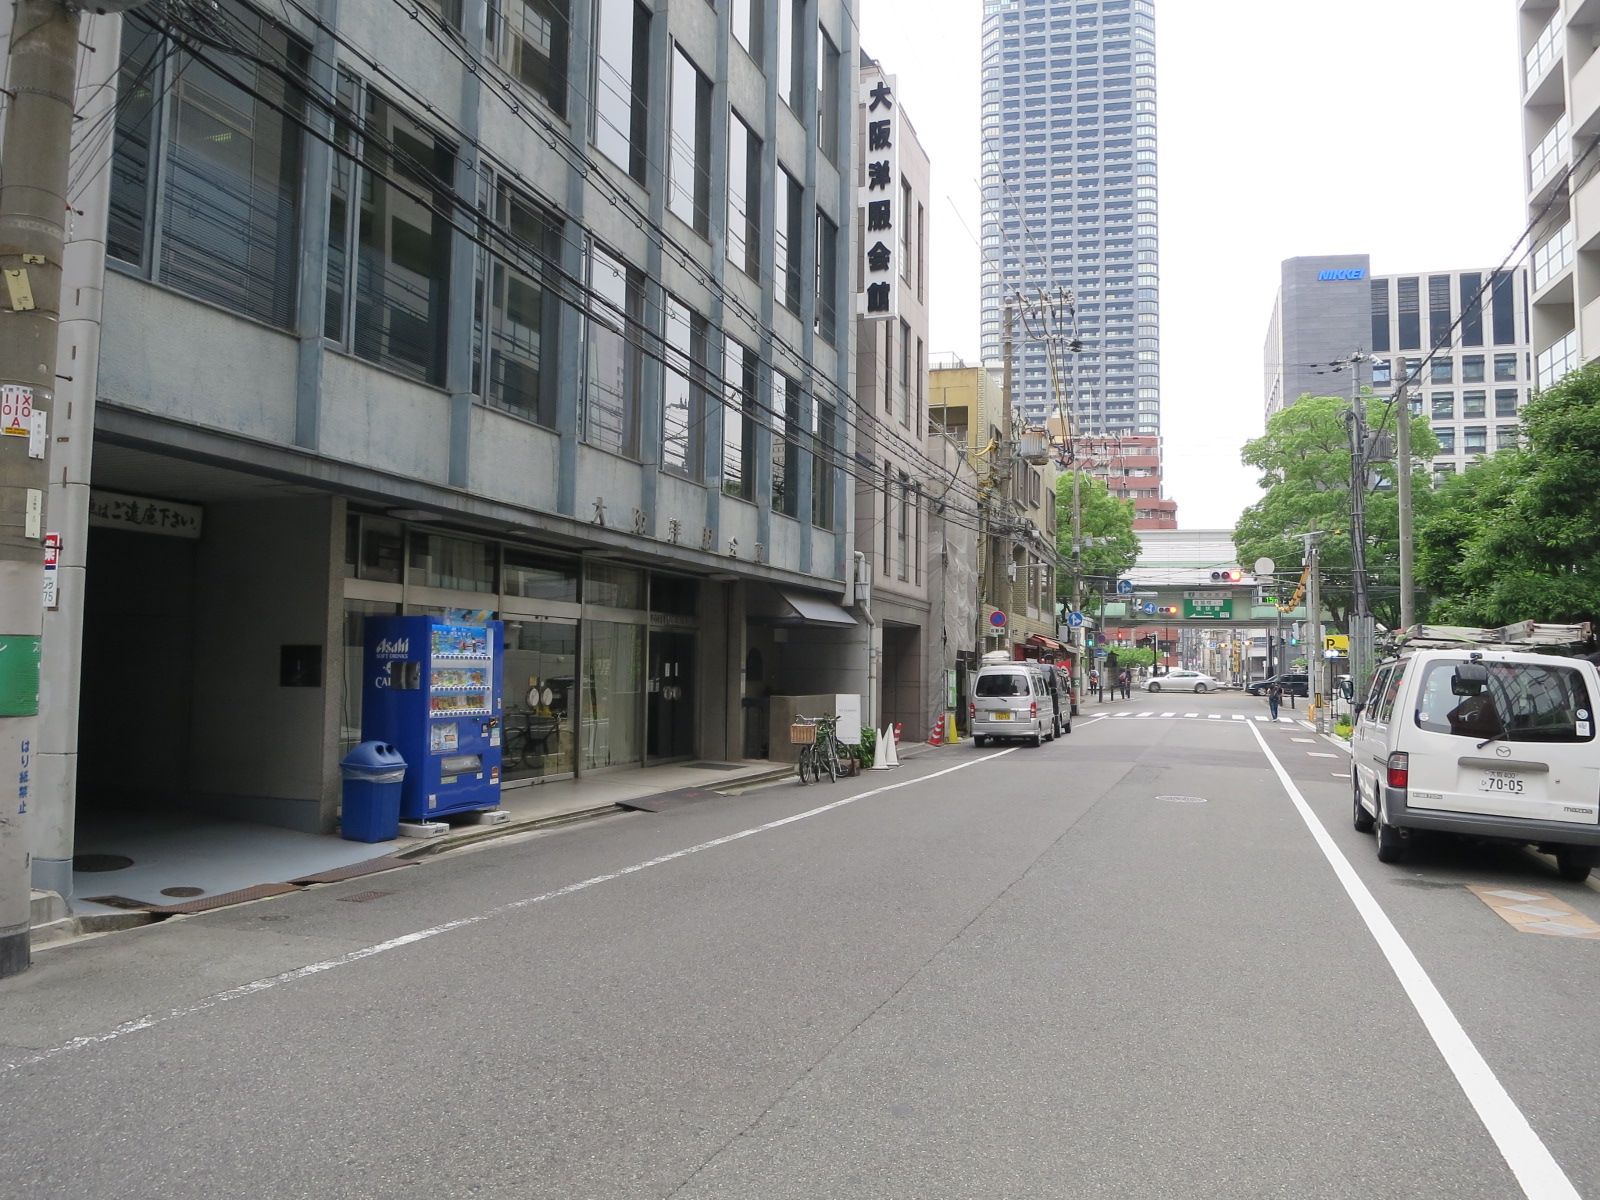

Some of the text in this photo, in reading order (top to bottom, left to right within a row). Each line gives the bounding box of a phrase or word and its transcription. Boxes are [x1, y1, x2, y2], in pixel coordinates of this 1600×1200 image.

[867, 81, 892, 312] 大阪洋服会館
[1318, 267, 1366, 281] NIKKEI
[375, 637, 409, 654] Asahi
[1326, 638, 1336, 650] P
[18, 740, 30, 815] はり紙禁止
[1488, 778, 1524, 792] 70-05
